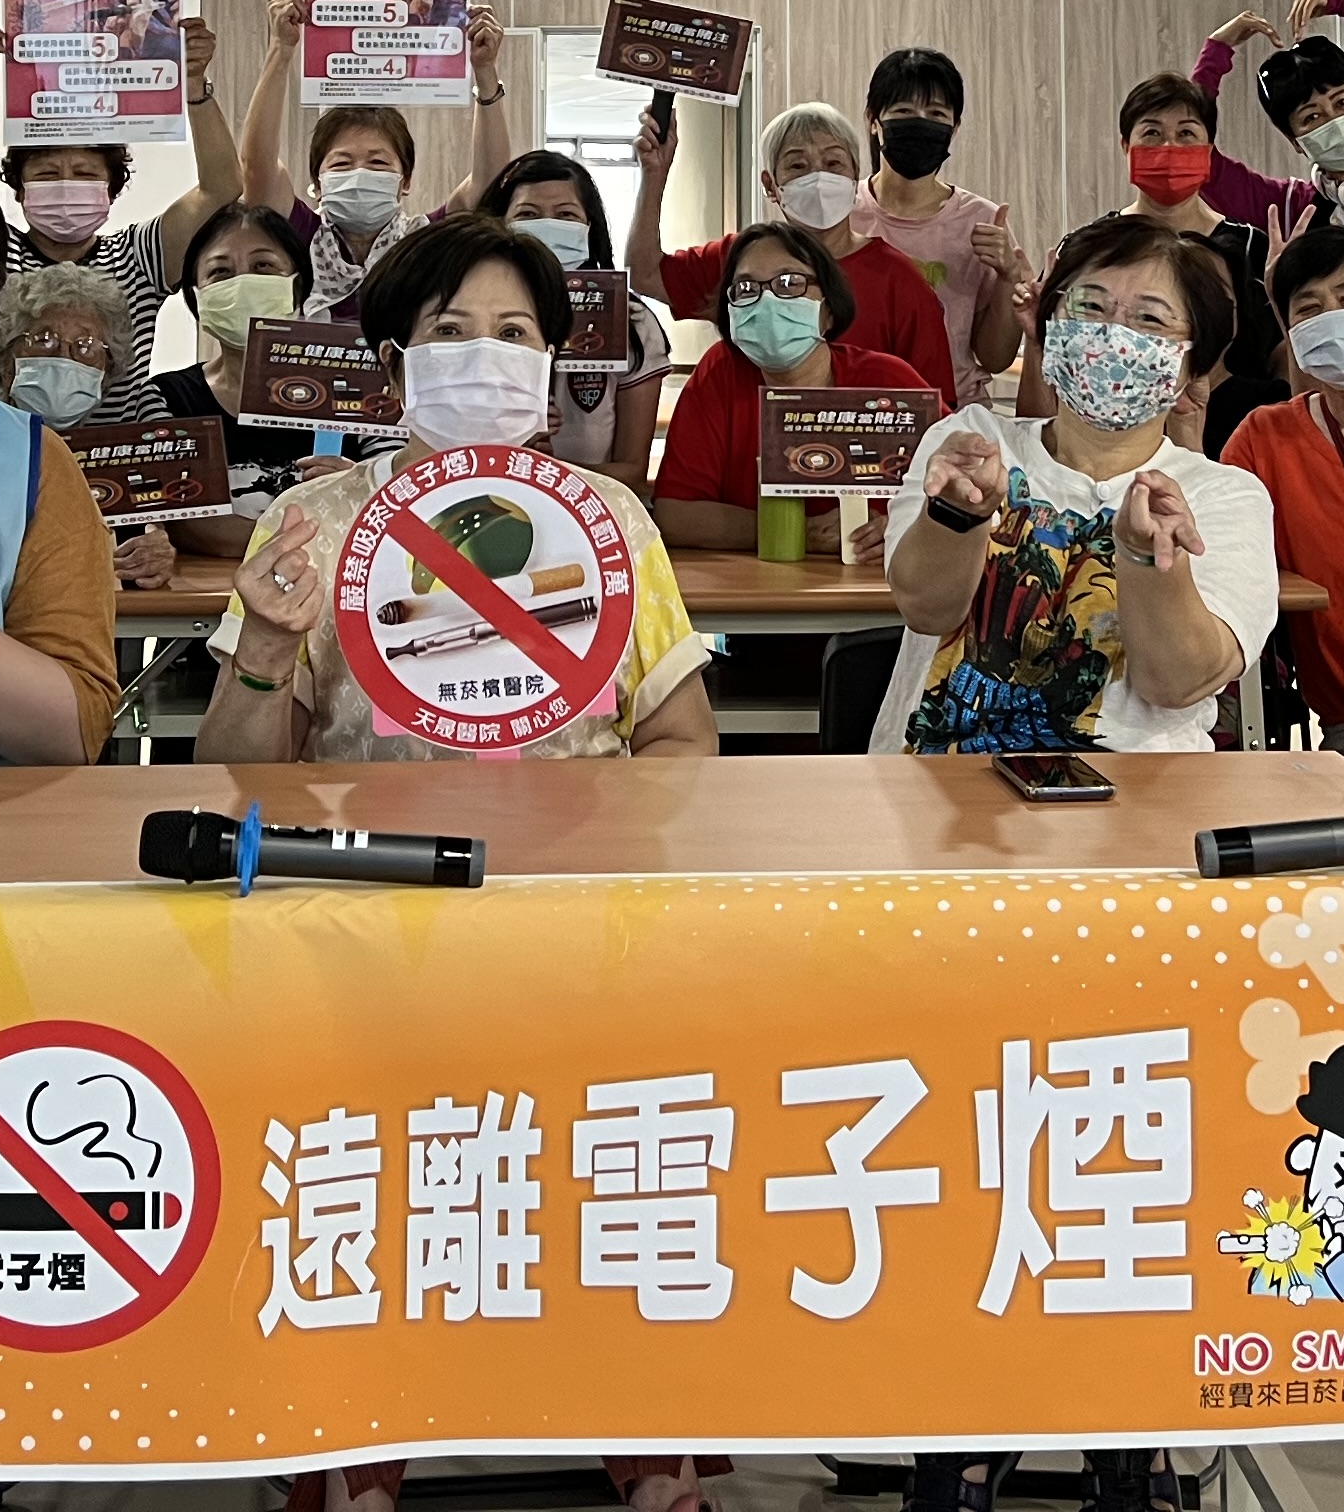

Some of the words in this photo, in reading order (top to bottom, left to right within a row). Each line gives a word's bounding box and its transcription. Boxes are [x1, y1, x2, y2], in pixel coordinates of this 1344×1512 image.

[383, 3, 397, 23] 5
[91, 35, 106, 58] 5
[438, 33, 450, 50] 7
[151, 67, 164, 84] 7
[383, 59, 394, 75] 4
[671, 67, 692, 76] NO
[93, 96, 106, 113] 4
[336, 401, 362, 410] NO
[783, 411, 916, 425] 別拿健康當賭注
[317, 423, 408, 437] 0800-63-63-63
[855, 464, 880, 474] NO
[136, 491, 163, 502] NO
[438, 674, 545, 702] 無菸檳醫院
[411, 707, 501, 743] 天晟醫院
[509, 695, 571, 739] 關心您
[257, 1028, 1193, 1338] 遠離電子煙
[1196, 1336, 1271, 1373] NO
